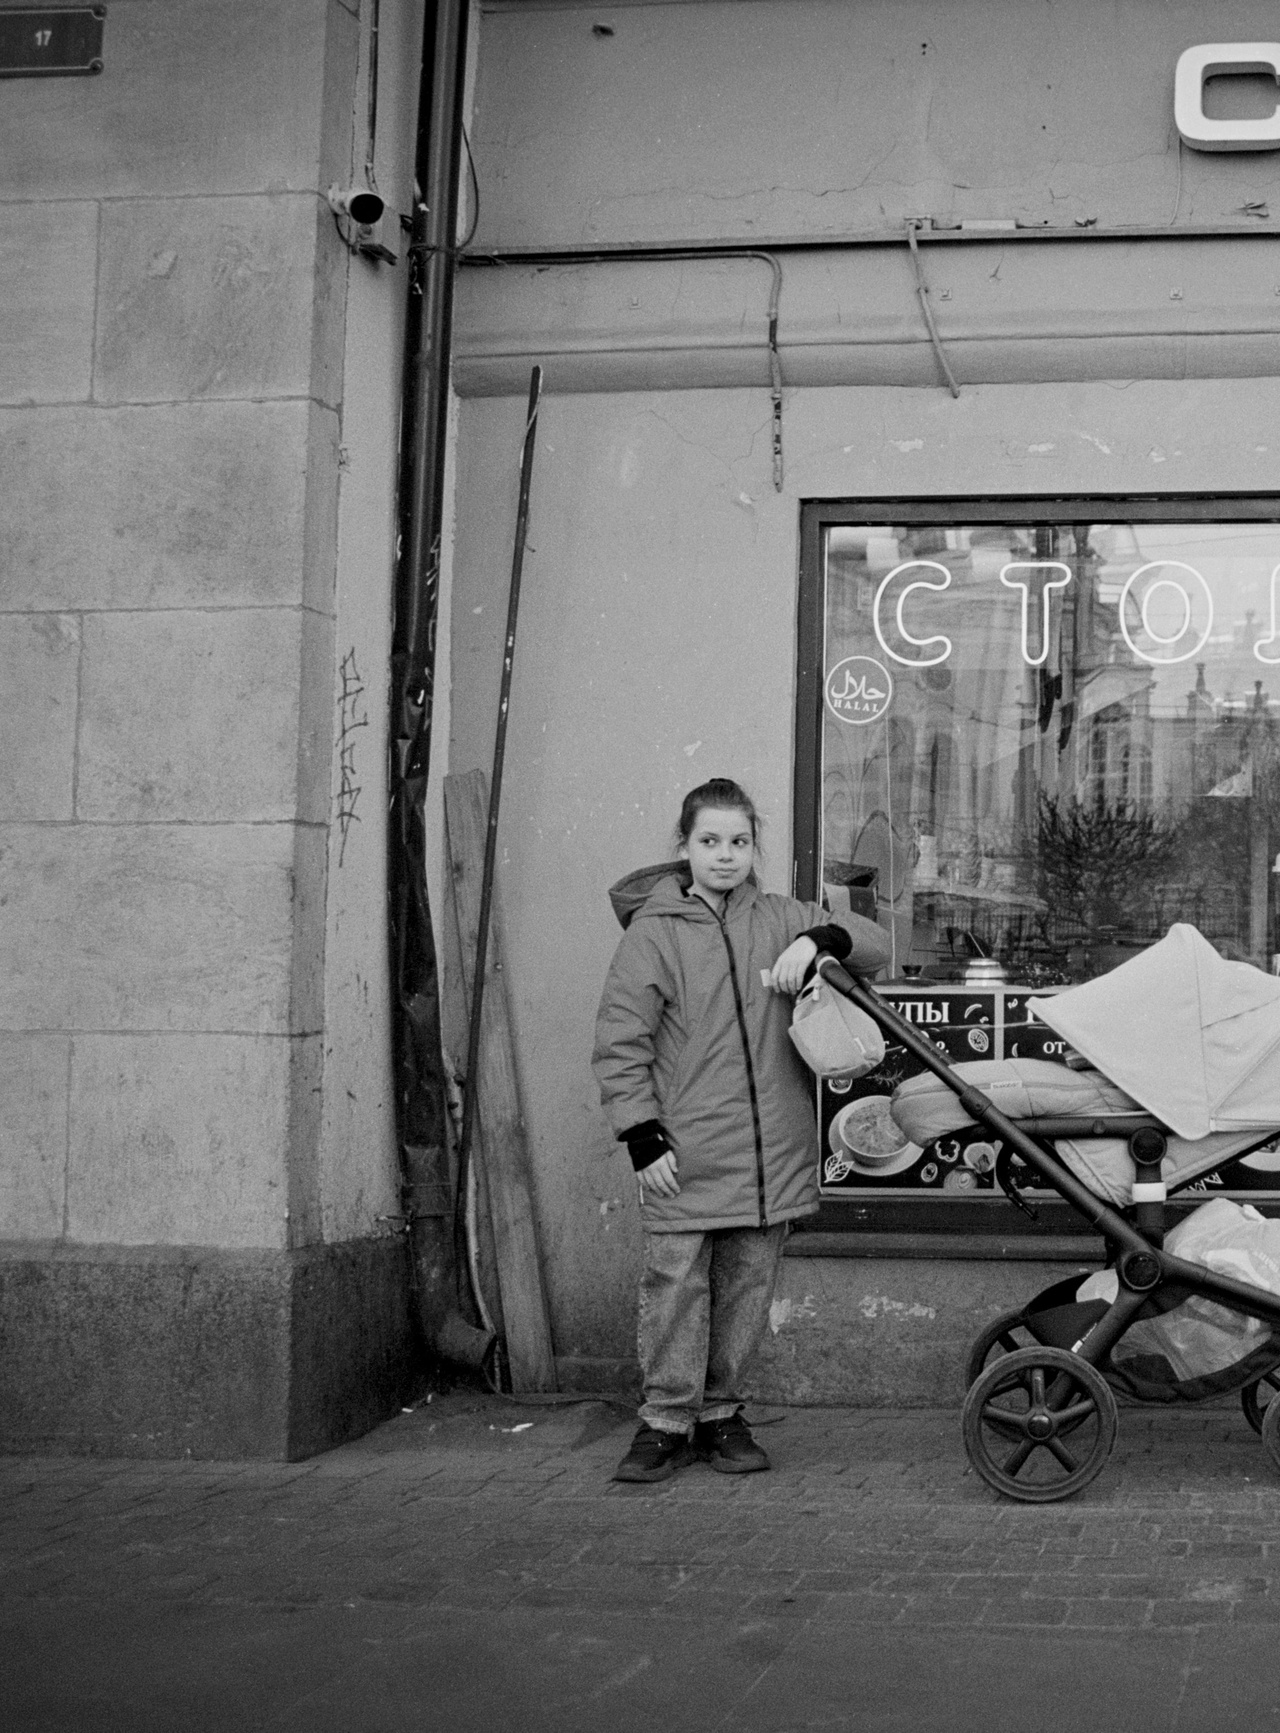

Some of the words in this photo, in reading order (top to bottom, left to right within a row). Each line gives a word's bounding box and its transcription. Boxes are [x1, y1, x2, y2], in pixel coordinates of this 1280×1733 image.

[35, 30, 52, 46] 17
[833, 699, 879, 712] HALAL
[888, 1001, 950, 1023] УПЫ
